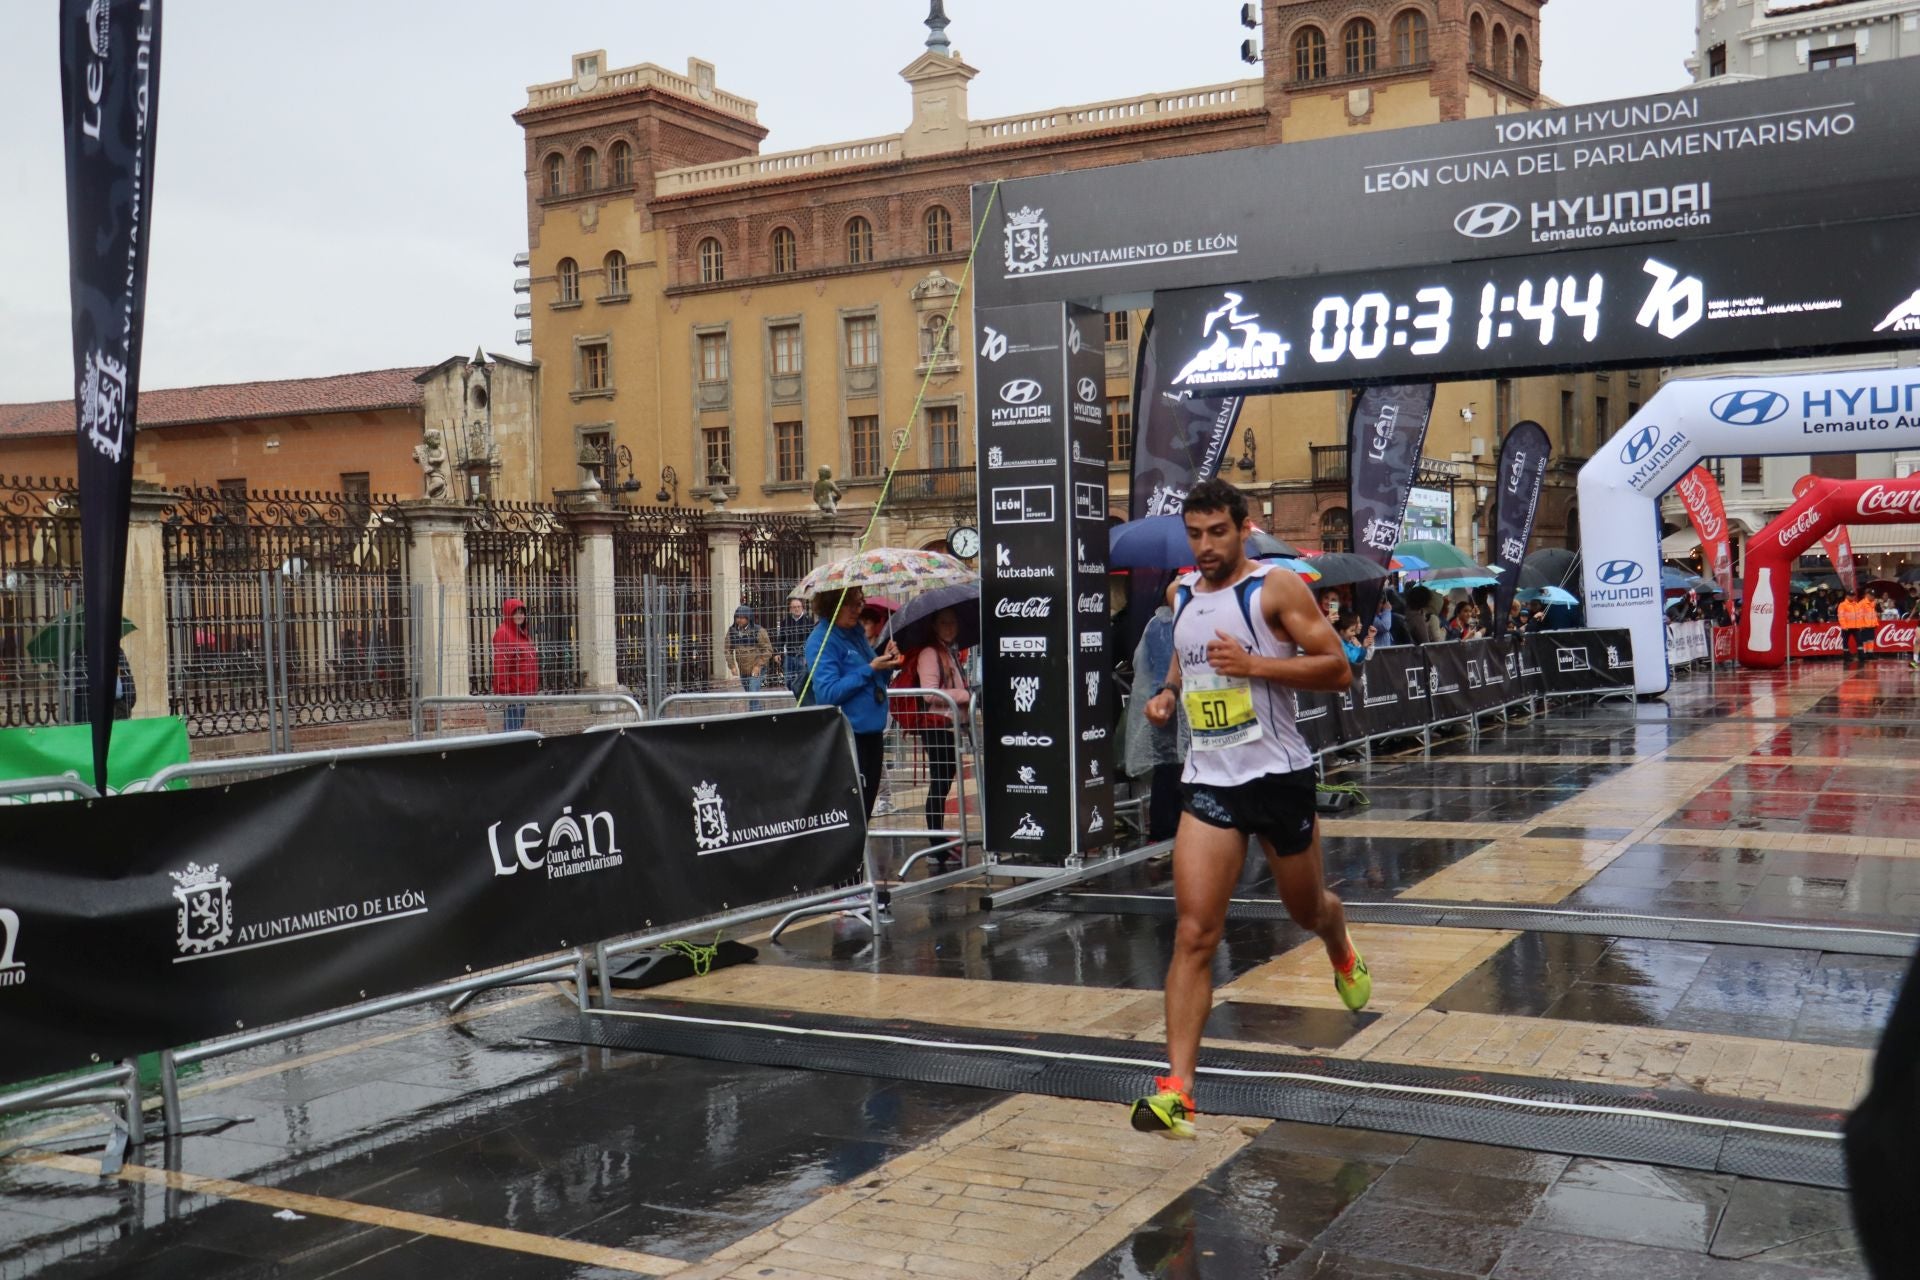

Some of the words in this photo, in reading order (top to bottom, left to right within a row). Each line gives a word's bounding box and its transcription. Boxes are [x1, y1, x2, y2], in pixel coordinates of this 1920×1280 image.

[1496, 117, 1567, 144] 10KM
[1575, 98, 1698, 134] HYUNDAI
[1364, 166, 1429, 194] LEÓN
[1436, 159, 1509, 185] CUNA
[1517, 152, 1566, 176] DEL
[1574, 113, 1856, 169] PARLAMENTARISMO
[1531, 182, 1710, 229] HYUNDAI
[1531, 220, 1603, 243] Lemauto
[1606, 211, 1711, 236] Automoción
[1052, 243, 1167, 267] AYUNTAMIENTO
[1172, 240, 1193, 254] DE
[1197, 233, 1238, 251] LEÓN
[992, 404, 1051, 420] HYUNDAI
[992, 419, 1016, 427] Lemauto
[1017, 417, 1051, 425] Automoción
[1074, 402, 1102, 418] HYUNDAI
[1803, 417, 1889, 434] Lemauto
[1192, 396, 1234, 487] YUNTAMIENT
[1628, 432, 1686, 487] HYUNDAI
[1636, 470, 1660, 491] Lemauto
[1659, 440, 1693, 471] Automoción
[996, 497, 1021, 511] LEÓN
[1778, 506, 1822, 547] Coca-Cola
[996, 566, 1055, 579] kutxabank
[1078, 562, 1105, 574] kutxabank
[1077, 593, 1104, 613] Coca-Cola
[1590, 586, 1653, 601] HYUNDAI
[995, 597, 1052, 618] Coca-Cola
[1201, 700, 1229, 728] 50
[1001, 731, 1053, 747] emico
[1082, 725, 1106, 741] emico
[731, 819, 808, 844] AYUNTAMIENTO
[807, 816, 819, 829] DE
[820, 809, 848, 825] LEÓN
[546, 850, 570, 865] Cuna
[571, 843, 586, 860] del
[547, 854, 623, 880] Parlamentarismo
[237, 903, 359, 943] AYUNTAMIENTO
[363, 897, 382, 916] DE
[387, 889, 426, 912] LEÓN
